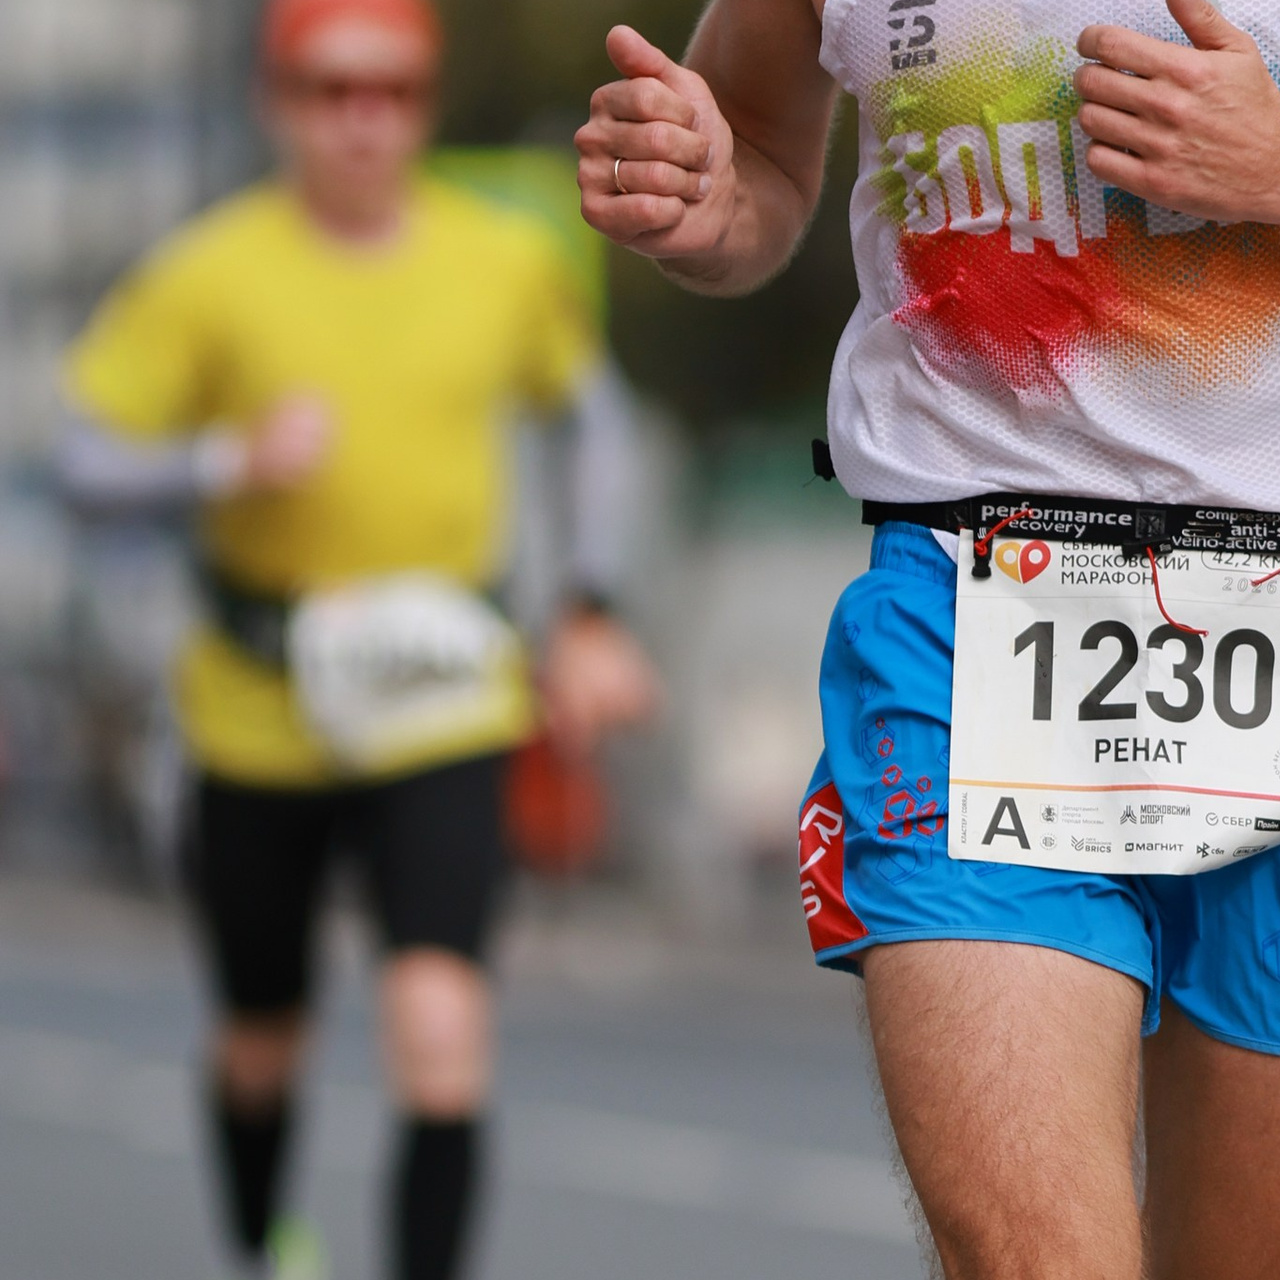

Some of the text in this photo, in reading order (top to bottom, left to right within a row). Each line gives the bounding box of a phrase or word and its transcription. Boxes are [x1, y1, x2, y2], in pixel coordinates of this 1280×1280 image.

[981, 502, 1133, 526] performance
[1003, 519, 1086, 538] ecovery
[1061, 553, 1190, 571] МОСКОВСКИЙ
[1212, 551, 1251, 568] 42,2
[1061, 570, 1154, 586] МАРАФОН
[1014, 620, 1275, 729] 1230
[1094, 737, 1188, 764] РЕНАТ
[1140, 804, 1191, 817] МОСКОВСКИЙ
[1140, 814, 1164, 825] СПОРТ
[1222, 816, 1252, 827] СБЕР
[1085, 845, 1112, 854] BRICS
[1136, 842, 1184, 852] магнит
